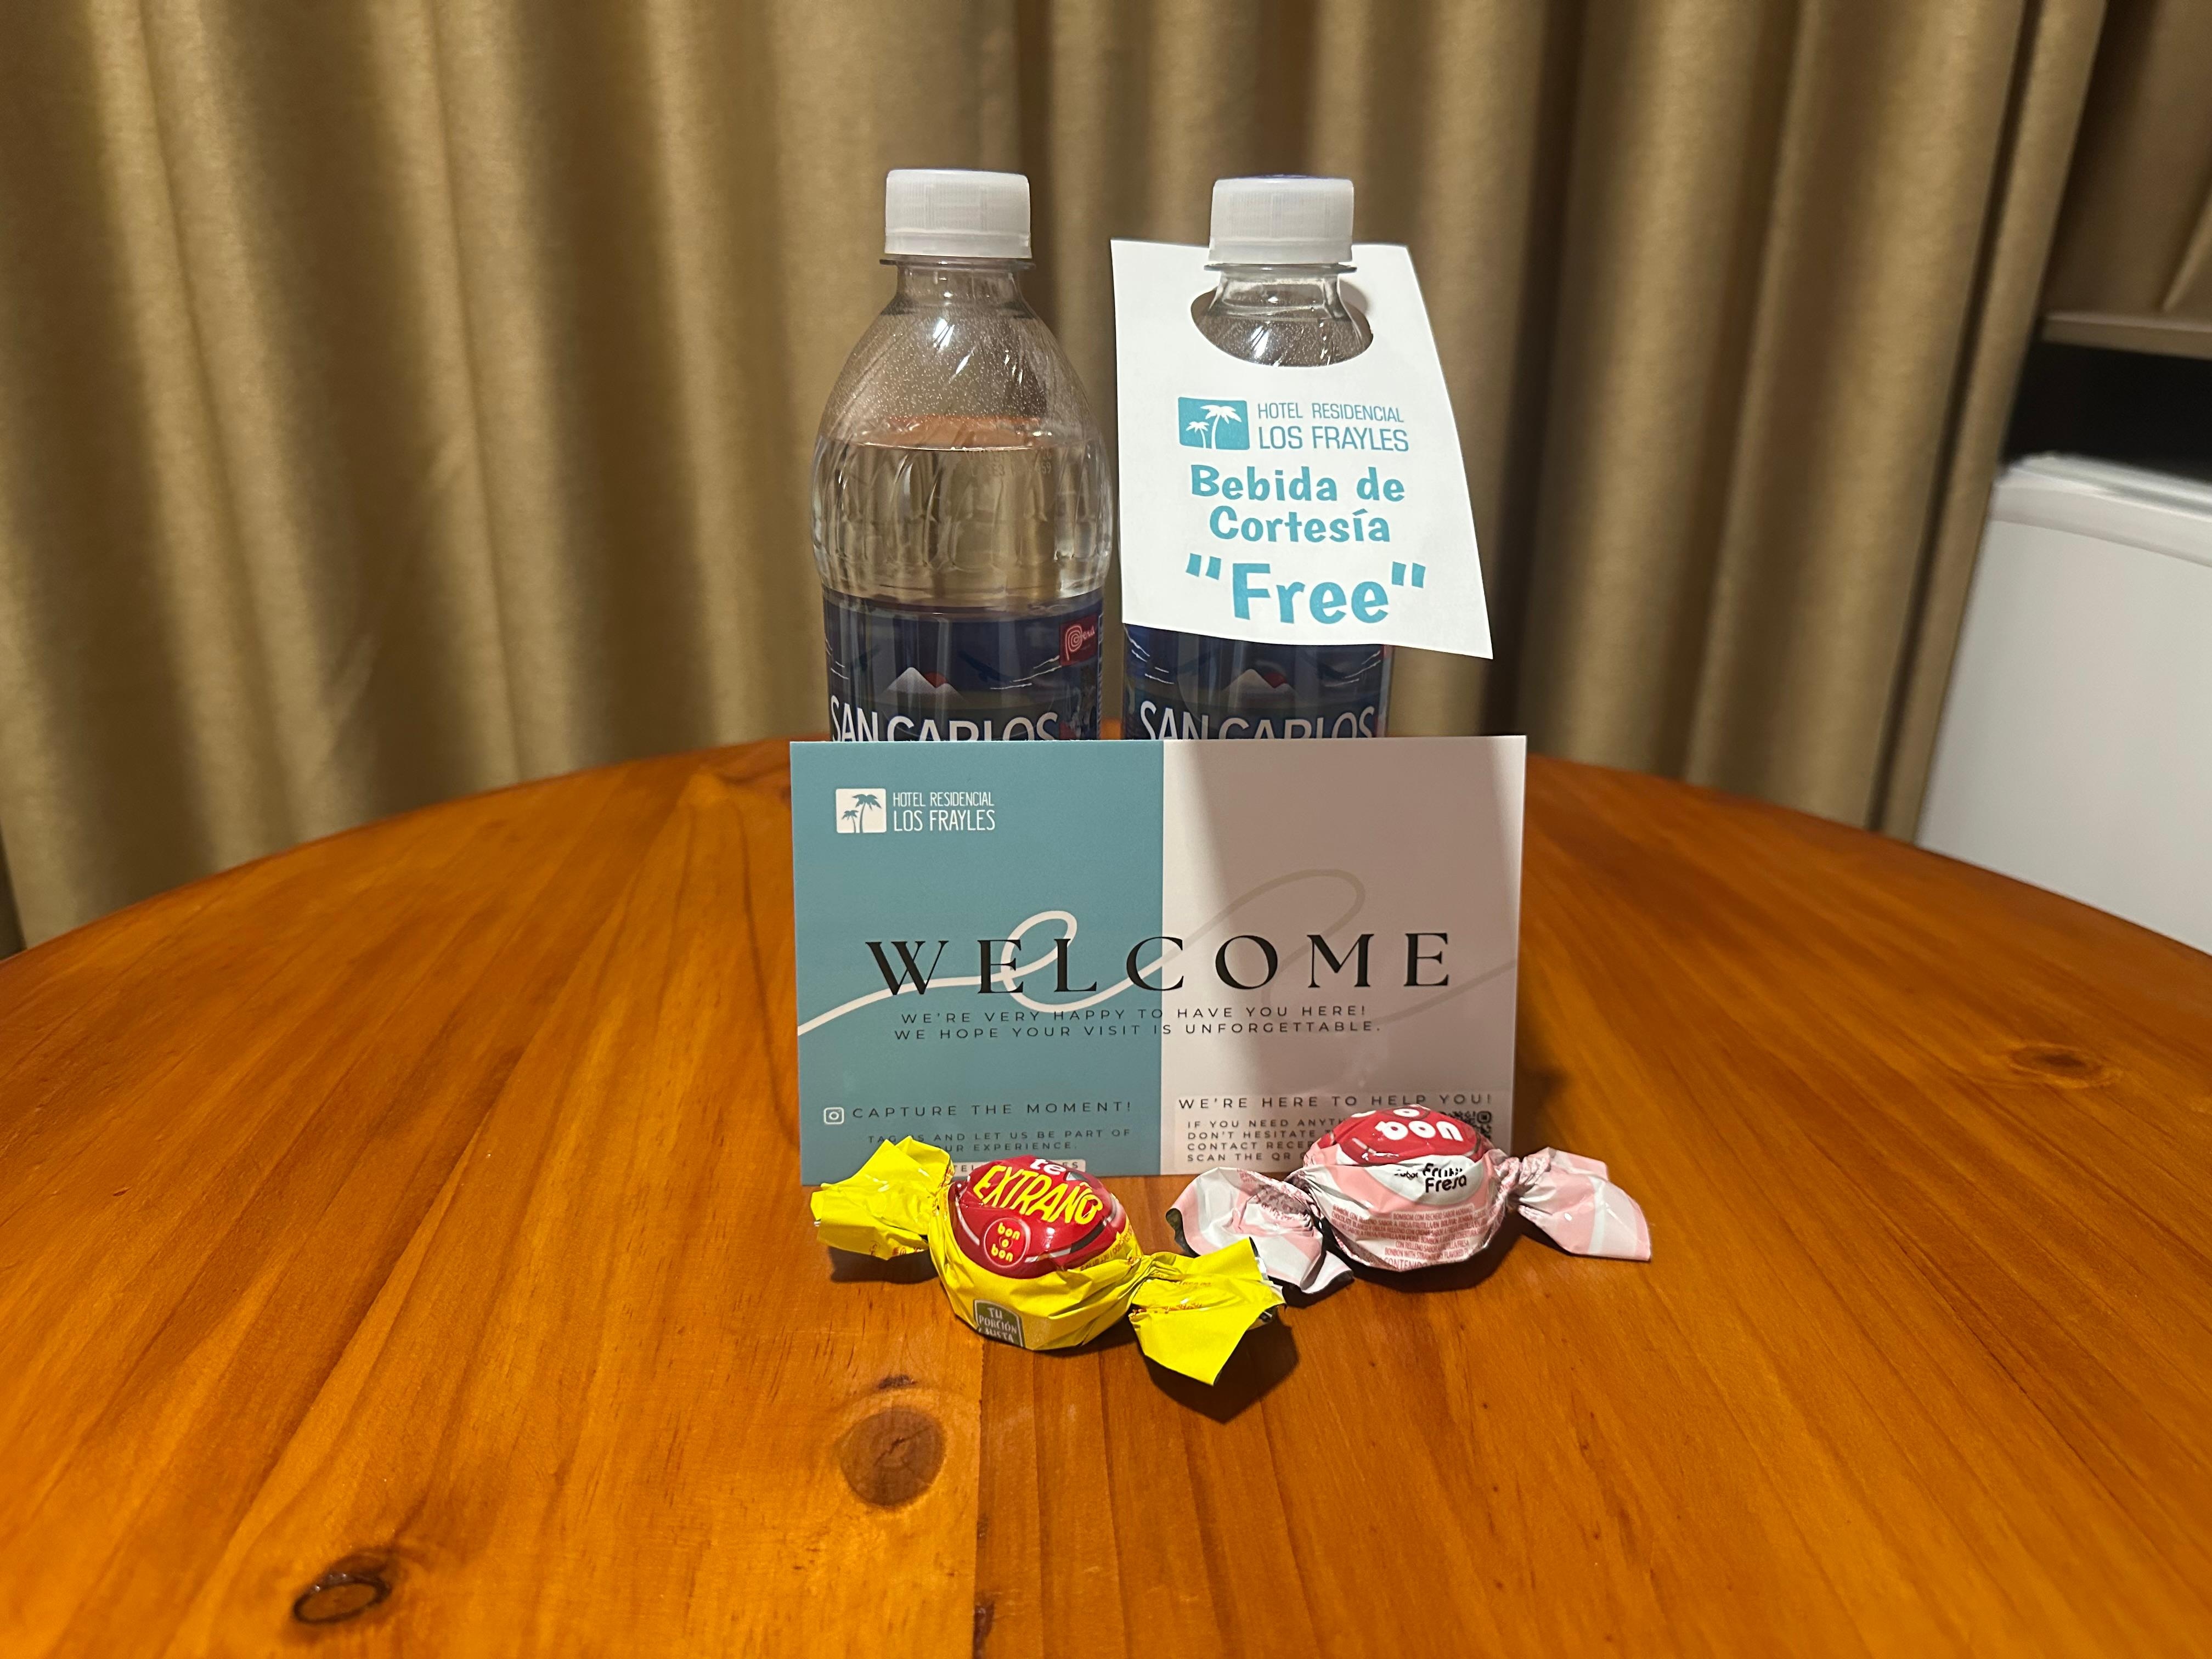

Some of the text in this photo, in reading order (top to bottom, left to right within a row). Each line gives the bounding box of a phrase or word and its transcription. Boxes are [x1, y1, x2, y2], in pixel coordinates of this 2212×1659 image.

[1258, 402, 1404, 423] HOTEL RESIDENCIAL
[1259, 426, 1409, 452] LOS FRAYLES
[1190, 464, 1405, 502] Bebida de
[1209, 505, 1390, 543] Cortesía
[1186, 553, 1426, 624] "Free"
[831, 695, 878, 741] SAN
[1140, 701, 1209, 739] SAN
[893, 791, 994, 806] HOTEL RESIDENCIAL
[893, 809, 995, 831] LOS FRAYLES
[865, 933, 1449, 995] WELCOME
[901, 1005, 1365, 1024] WE'RE VERY HAPPY TO HAVE YOU HERE!
[894, 1021, 1381, 1041] WE HOPE YOUR VISIT IS UNFORGETTABLE.
[853, 1101, 1131, 1119] CAPTURE THE MOMENT!
[1179, 1093, 1491, 1109] WE'RE HERE TO HELP YOU!
[1249, 1119, 1289, 1127] NEED
[868, 1135, 896, 1143] TAG
[934, 1133, 966, 1142] AND
[975, 1132, 1000, 1141] LET
[1010, 1131, 1028, 1139] US
[1064, 1130, 1104, 1138] PART
[1111, 1128, 1132, 1137] OF
[1188, 1130, 1314, 1139] DON'T HESITATE
[974, 1142, 1077, 1152] EXPERIENCE.
[1187, 1142, 1257, 1150] CONTACT
[1188, 1154, 1226, 1162] SCAN
[1272, 1152, 1291, 1161] QR
[1030, 1158, 1066, 1176] te
[1425, 1175, 1467, 1193] Fresa
[997, 1222, 1020, 1242] bon
[991, 1243, 1014, 1262] bon
[1001, 1239, 1009, 1248] o
[988, 1307, 1003, 1319] TU
[979, 1314, 1018, 1334] PORCIÓN
